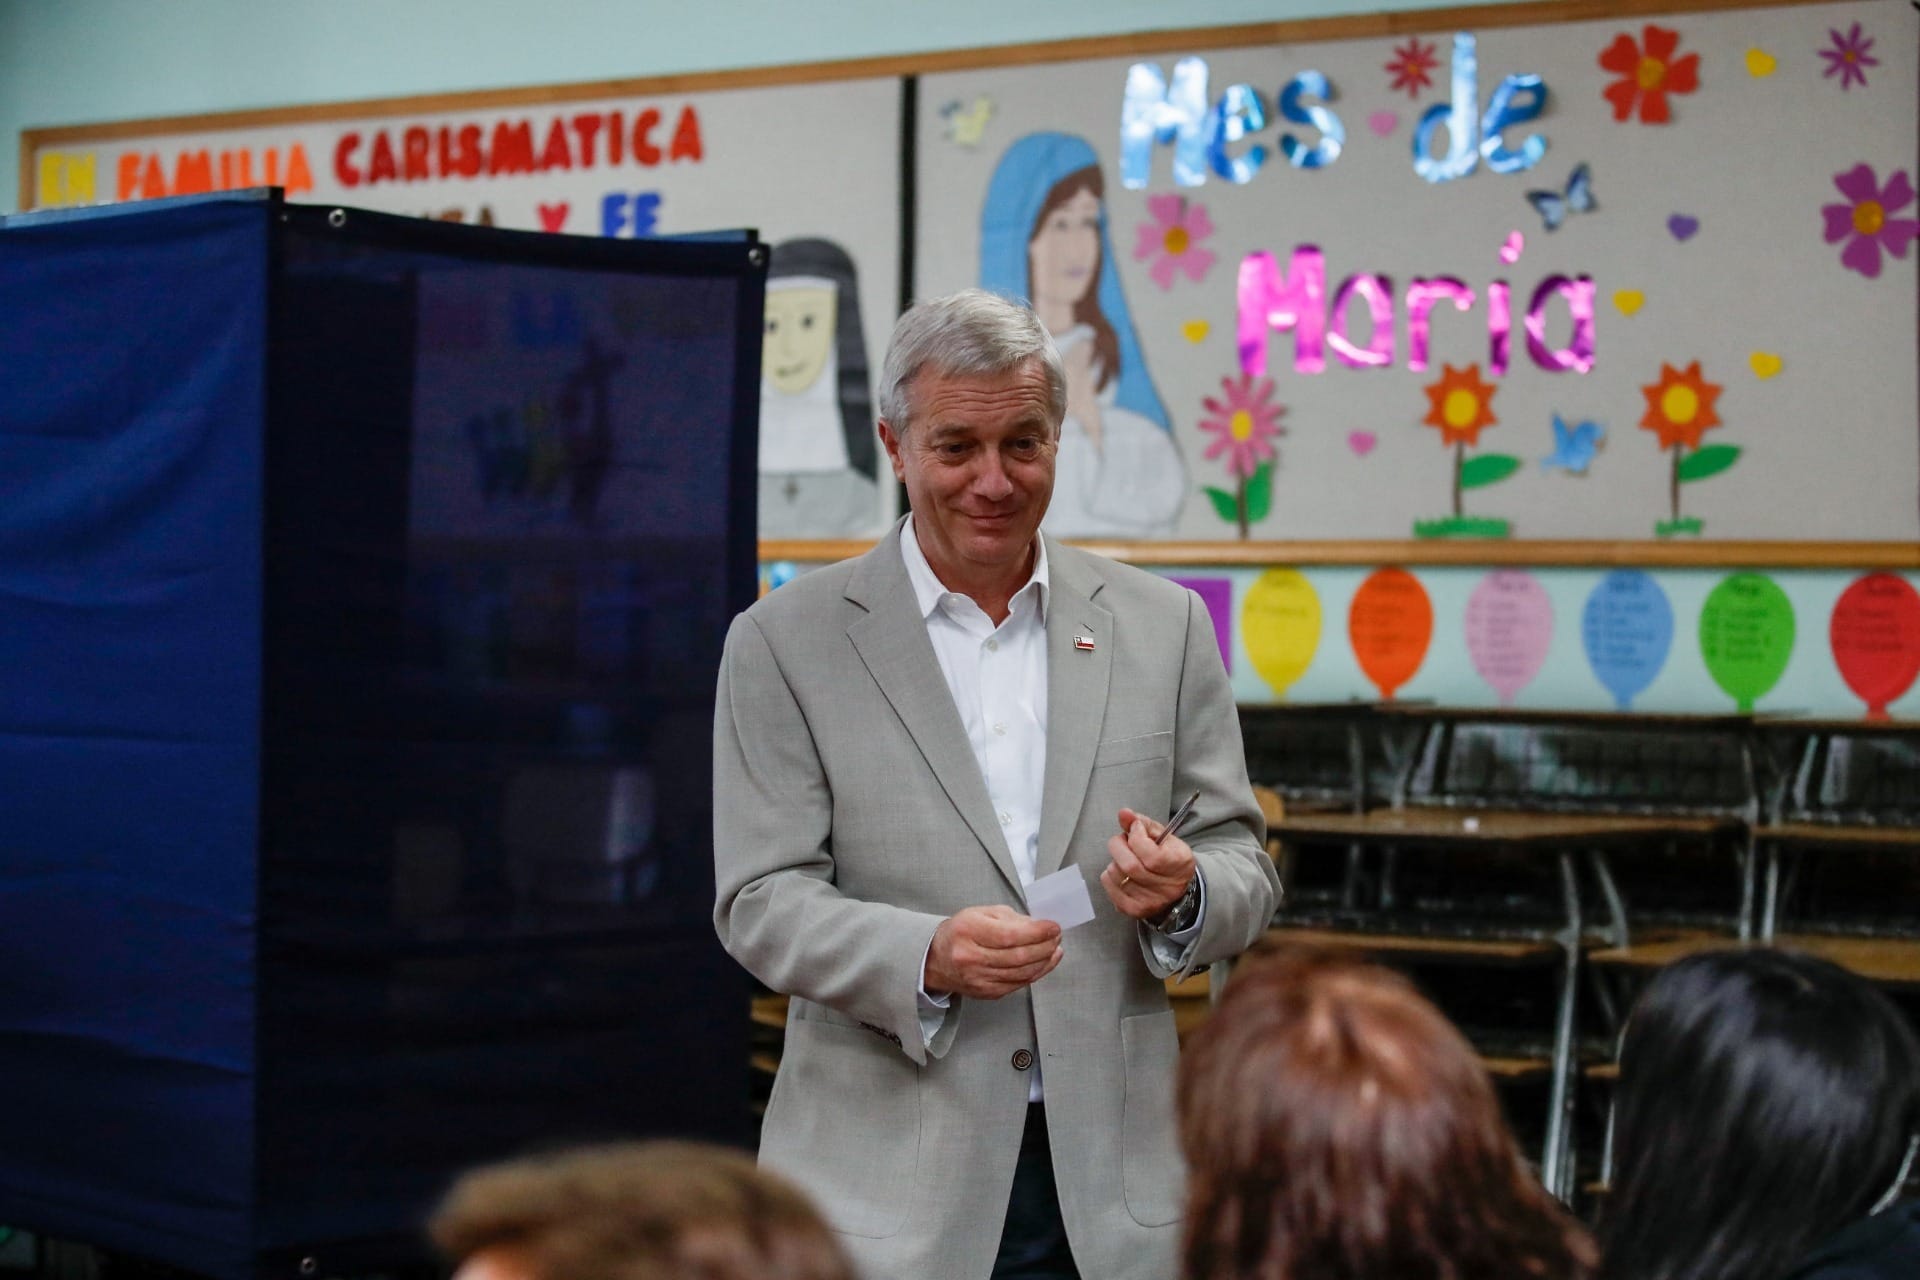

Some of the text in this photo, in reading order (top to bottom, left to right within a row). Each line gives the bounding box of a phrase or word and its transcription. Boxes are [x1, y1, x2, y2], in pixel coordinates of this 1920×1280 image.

[40, 105, 704, 206] EN FAMILIA CARISMATICA
[1120, 32, 1550, 189] Mes de
[1237, 231, 1597, 376] María
